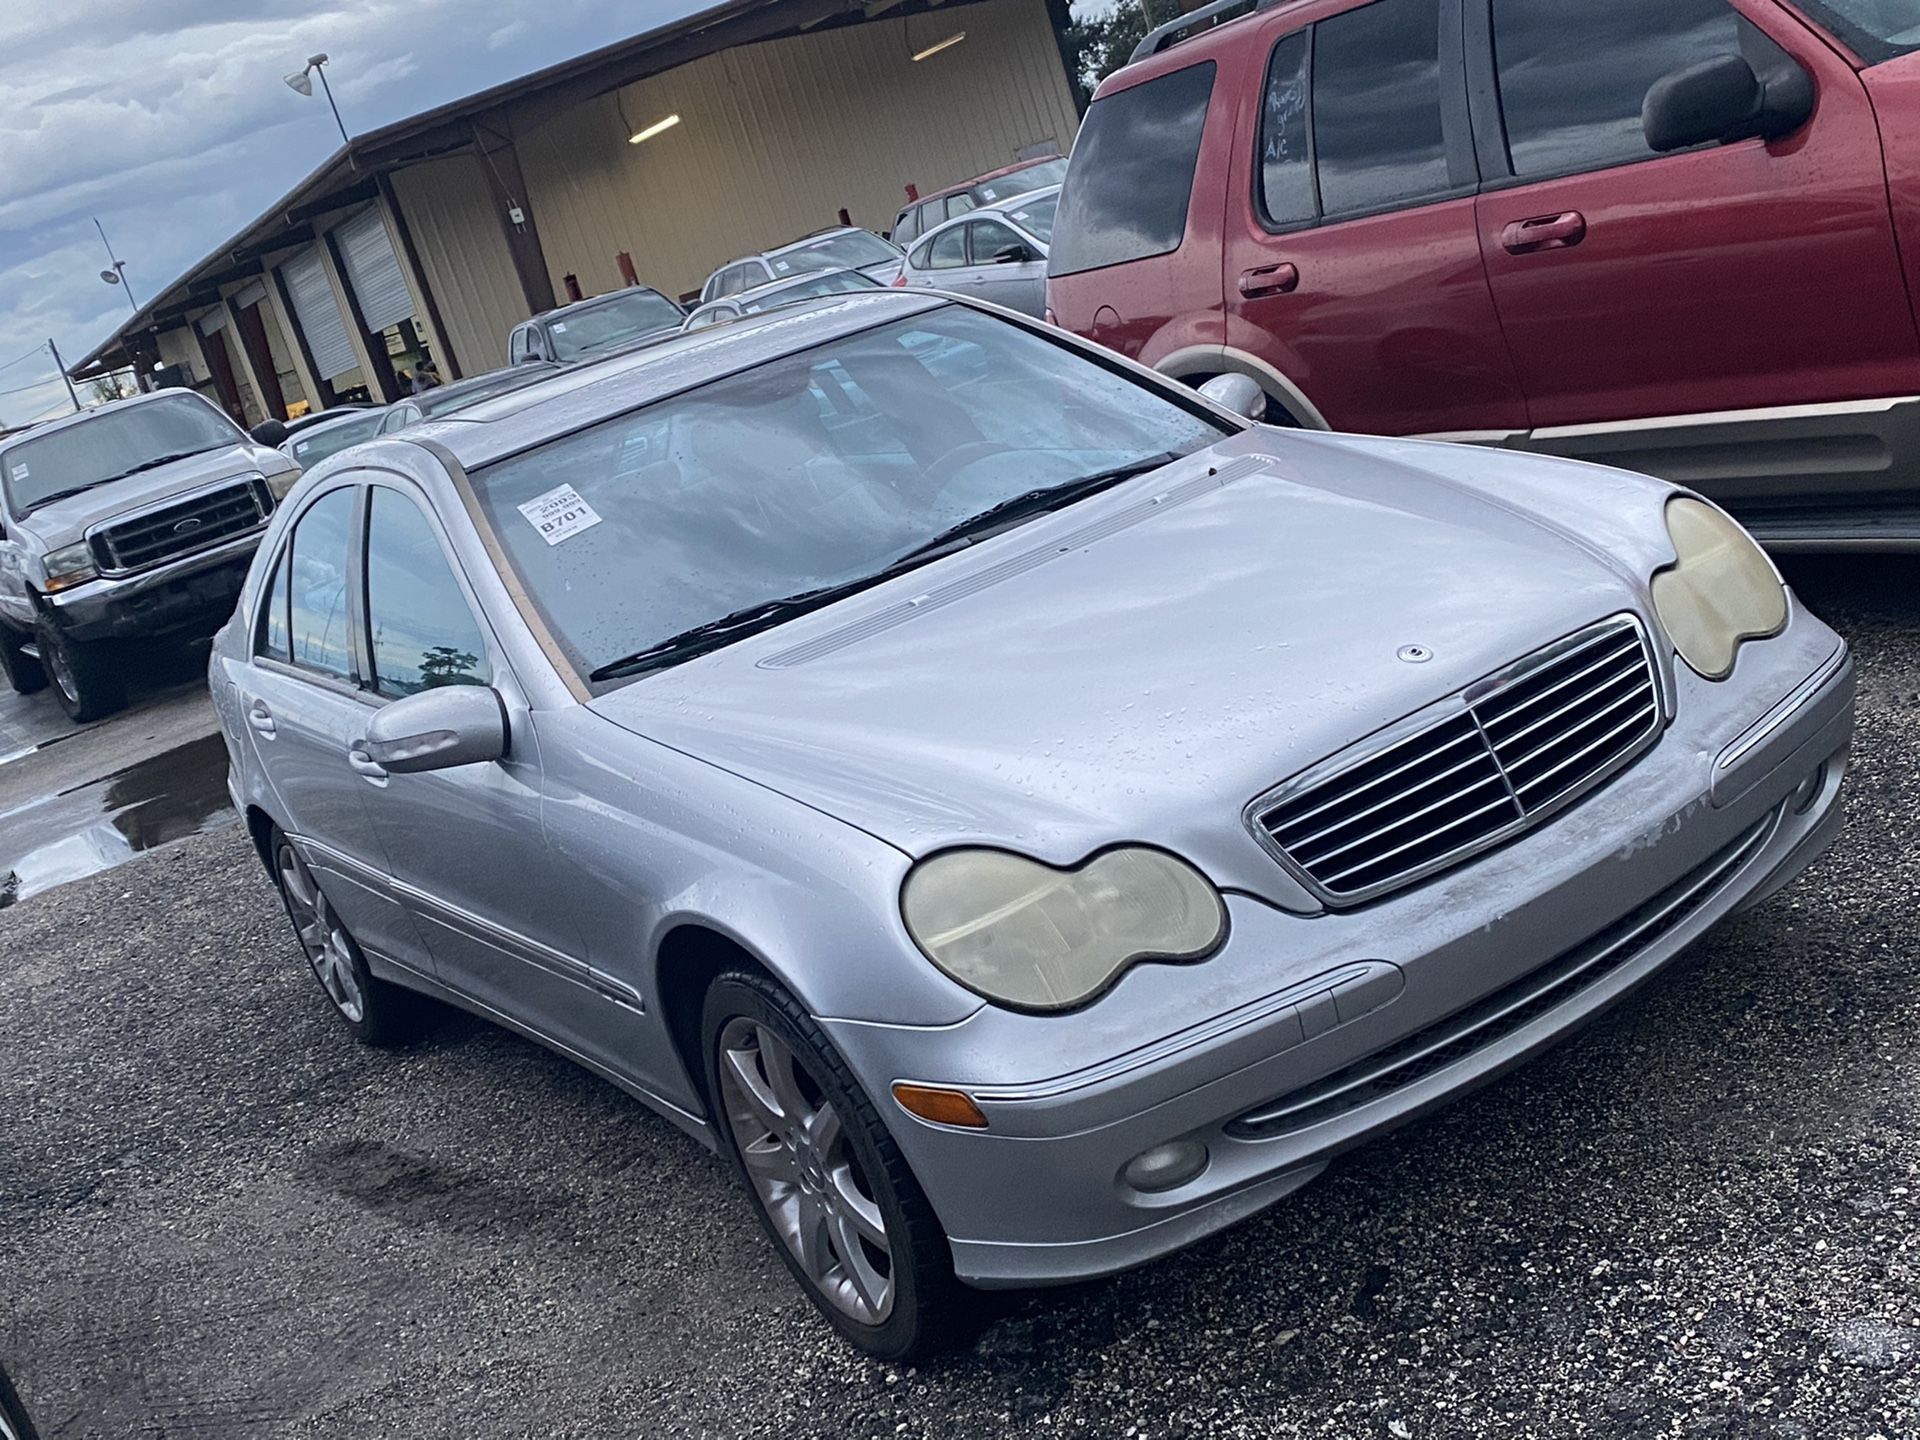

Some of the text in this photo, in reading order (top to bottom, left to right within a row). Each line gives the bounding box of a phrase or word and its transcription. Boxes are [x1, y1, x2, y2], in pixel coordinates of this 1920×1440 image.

[1264, 137, 1288, 159] A/C
[539, 493, 577, 513] 2003
[540, 507, 586, 532] B701
